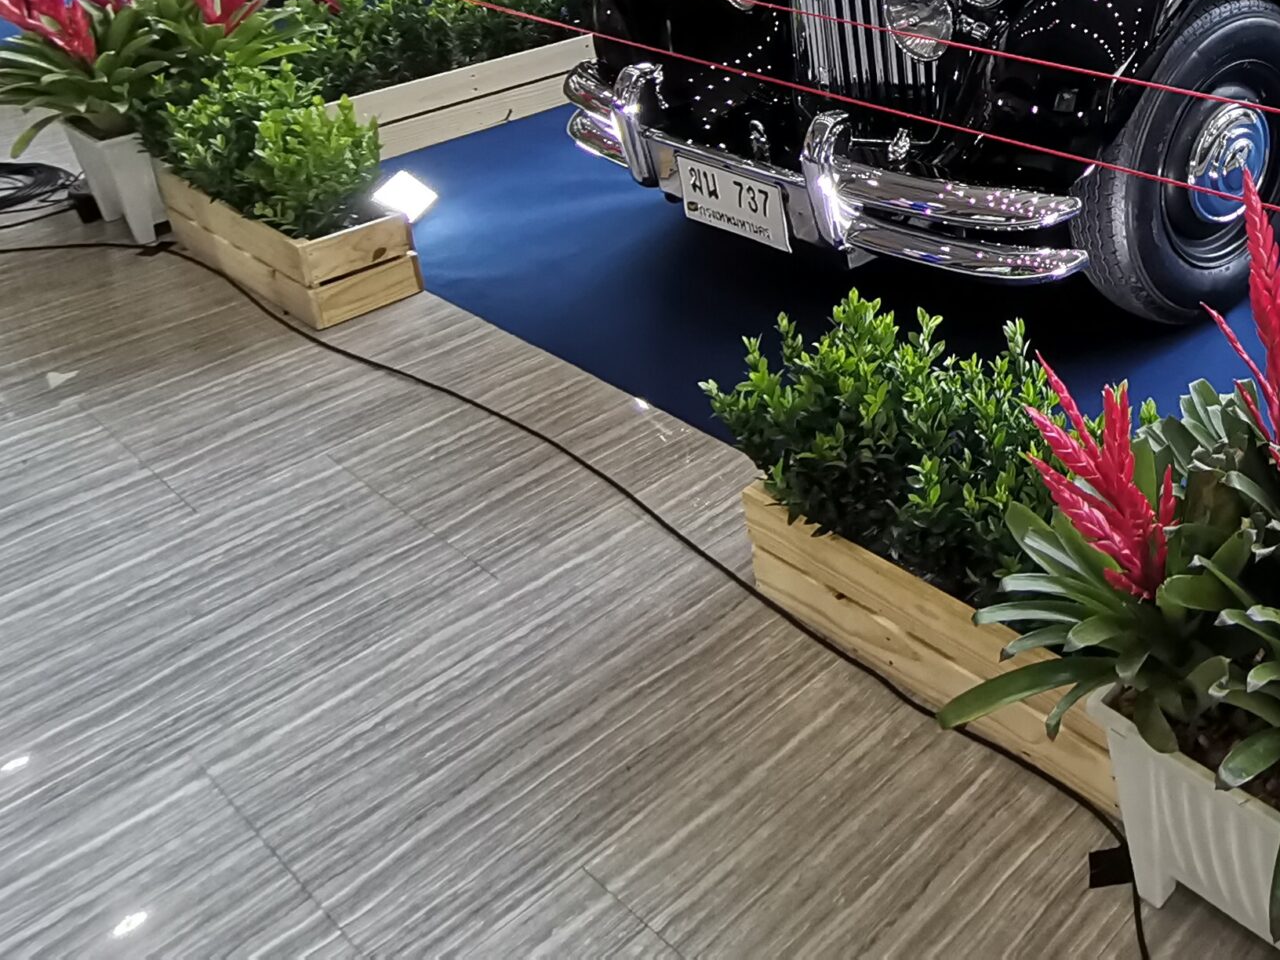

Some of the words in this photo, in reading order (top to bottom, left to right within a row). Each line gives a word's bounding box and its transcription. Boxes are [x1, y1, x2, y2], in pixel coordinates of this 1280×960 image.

[732, 180, 770, 218] 737
[699, 205, 772, 241] กรุงเทพมหานคร
